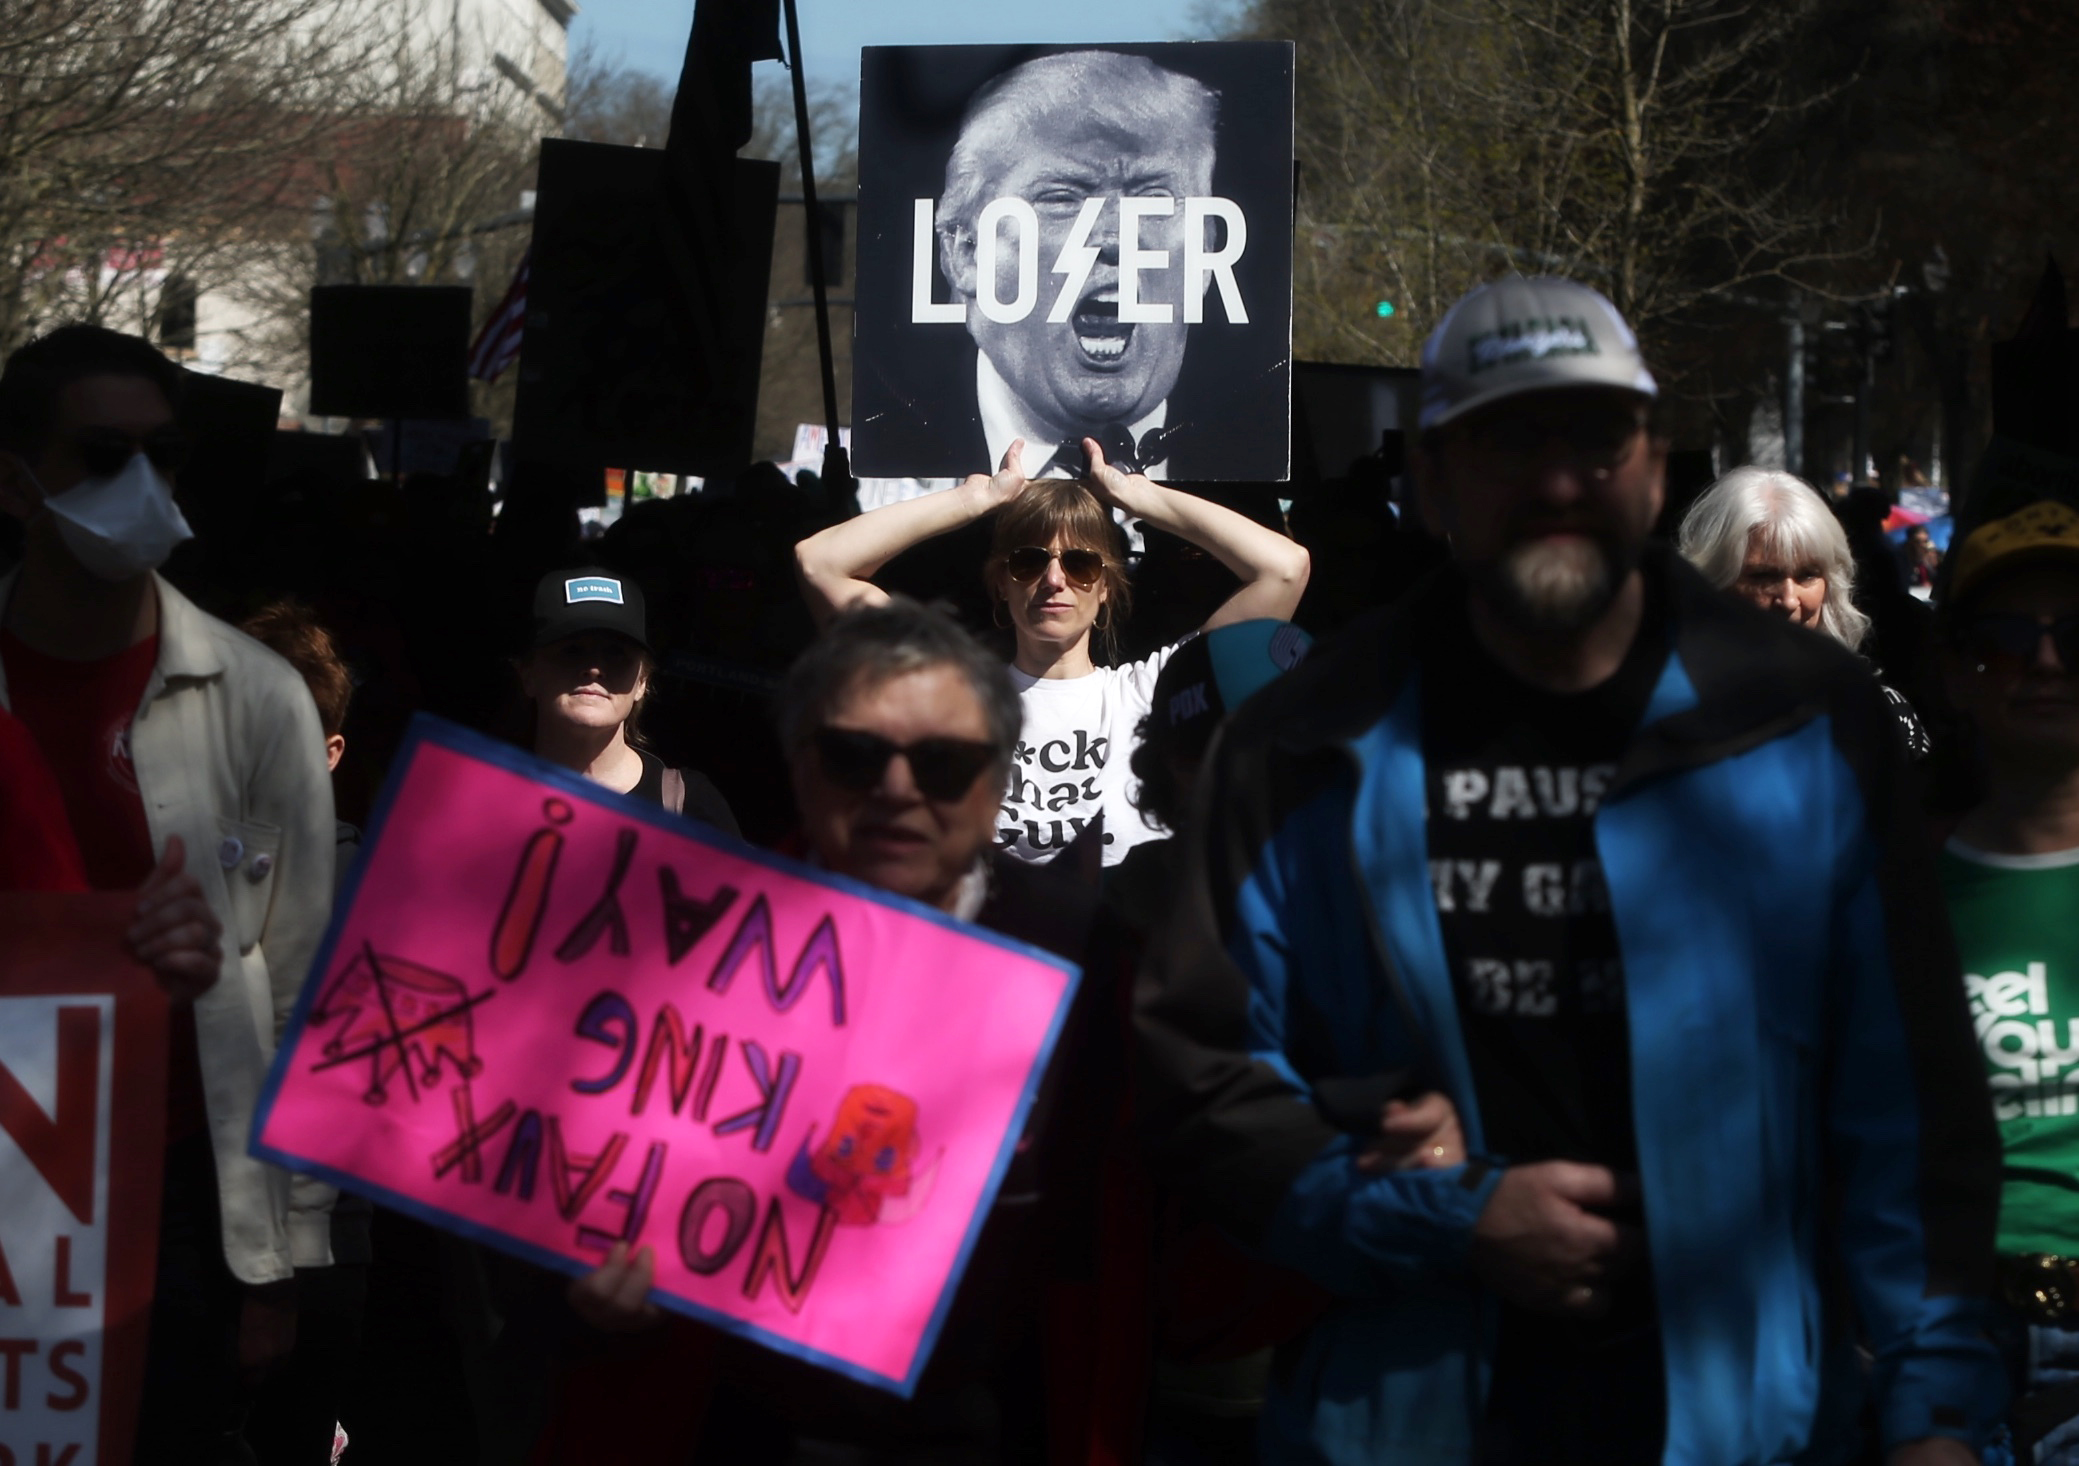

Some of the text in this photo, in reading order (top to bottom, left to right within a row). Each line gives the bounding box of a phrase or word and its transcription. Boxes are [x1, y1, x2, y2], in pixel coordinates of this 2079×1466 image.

[576, 584, 613, 594] no trash
[1014, 729, 1108, 773] ck
[1442, 764, 1619, 821] PAUS
[571, 989, 803, 1153] KING
[677, 1176, 839, 1315] NO
